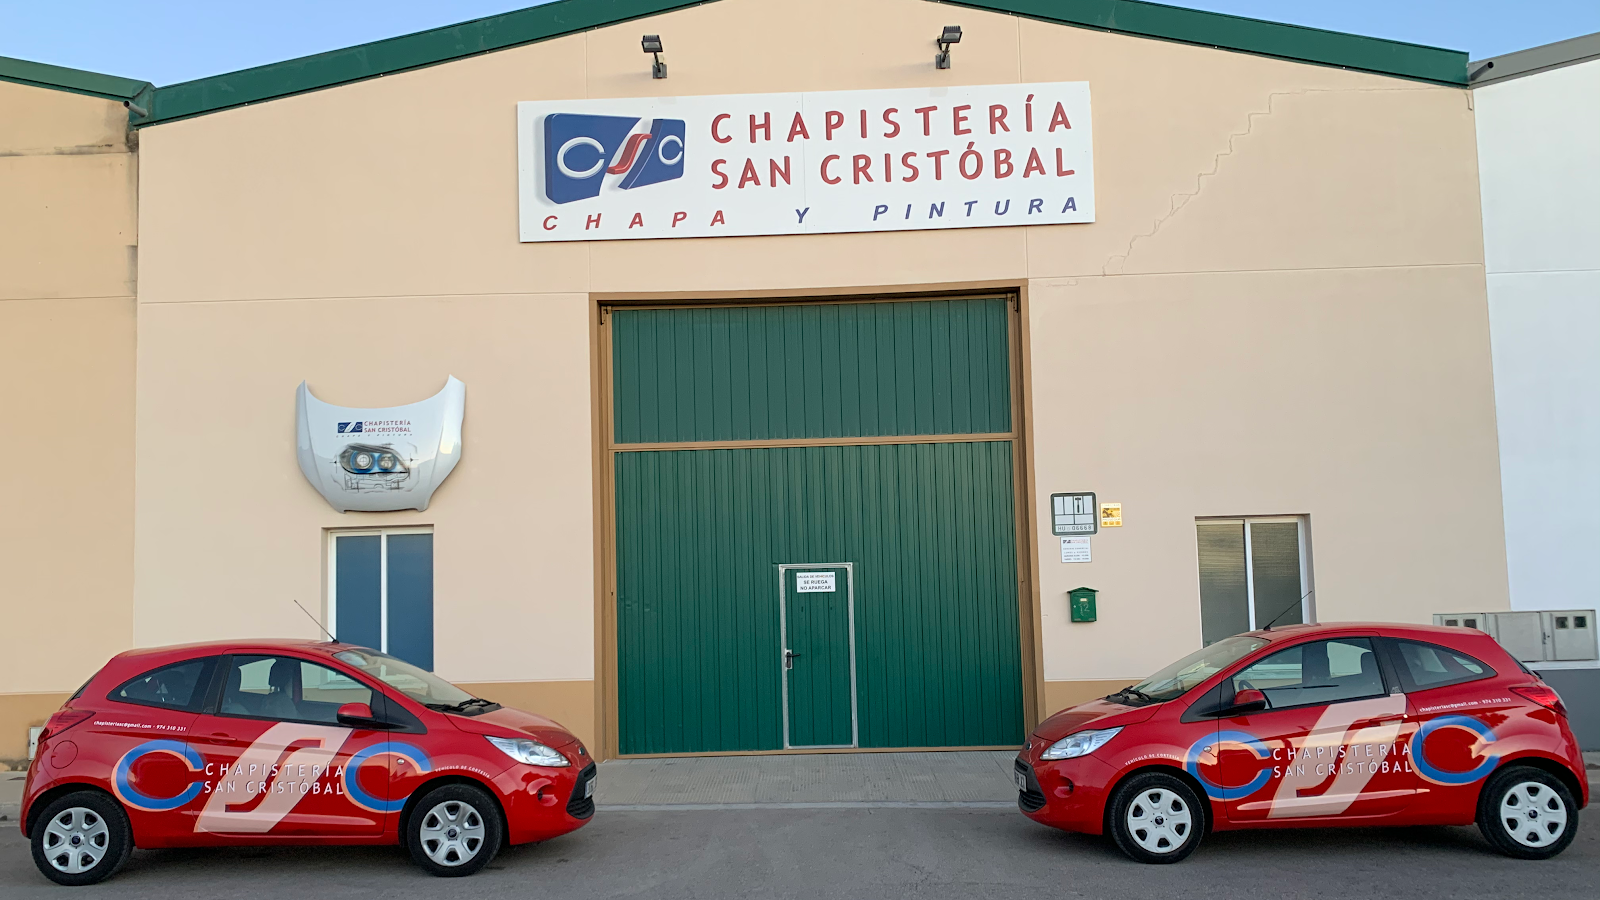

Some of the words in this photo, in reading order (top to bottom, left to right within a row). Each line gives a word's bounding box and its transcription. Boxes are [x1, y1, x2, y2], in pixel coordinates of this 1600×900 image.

[711, 93, 1072, 144] CHAPISTERÍA
[710, 155, 791, 190] SAN
[820, 141, 1075, 185] CRISTÓBAL
[542, 209, 726, 231] CHAPA
[795, 207, 810, 224] Y
[872, 196, 1078, 222] PINTURA
[363, 419, 411, 427] CHAPISTERÍA
[1272, 740, 1412, 761] CHAPISTERÍA
[204, 760, 344, 778] CHAPISTERÍA
[1273, 763, 1305, 778] SAN
[1315, 759, 1413, 776] CRISTÓBAL
[203, 780, 236, 795] SAN
[245, 778, 344, 795] CRISTÓBAL
